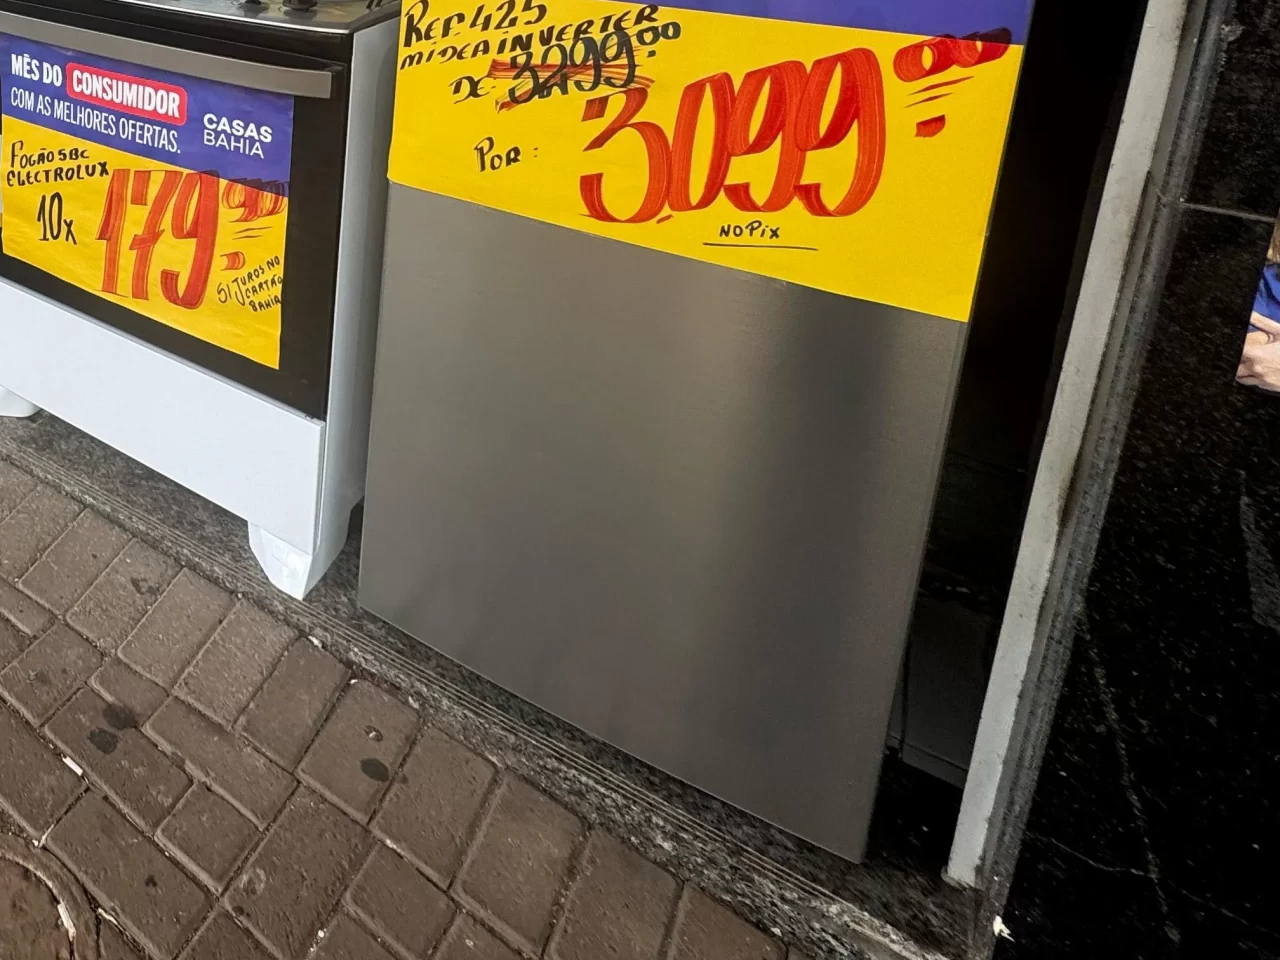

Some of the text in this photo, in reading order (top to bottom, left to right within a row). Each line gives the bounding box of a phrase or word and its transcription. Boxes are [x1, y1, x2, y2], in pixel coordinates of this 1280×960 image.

[11, 52, 180, 118] MÊS DO CONSUMIDOR
[11, 87, 181, 154] COM AS MELHORES OFERTAS.
[203, 113, 273, 143] CASAS
[204, 129, 265, 159] BAHIA
[266, 255, 281, 270] NO
